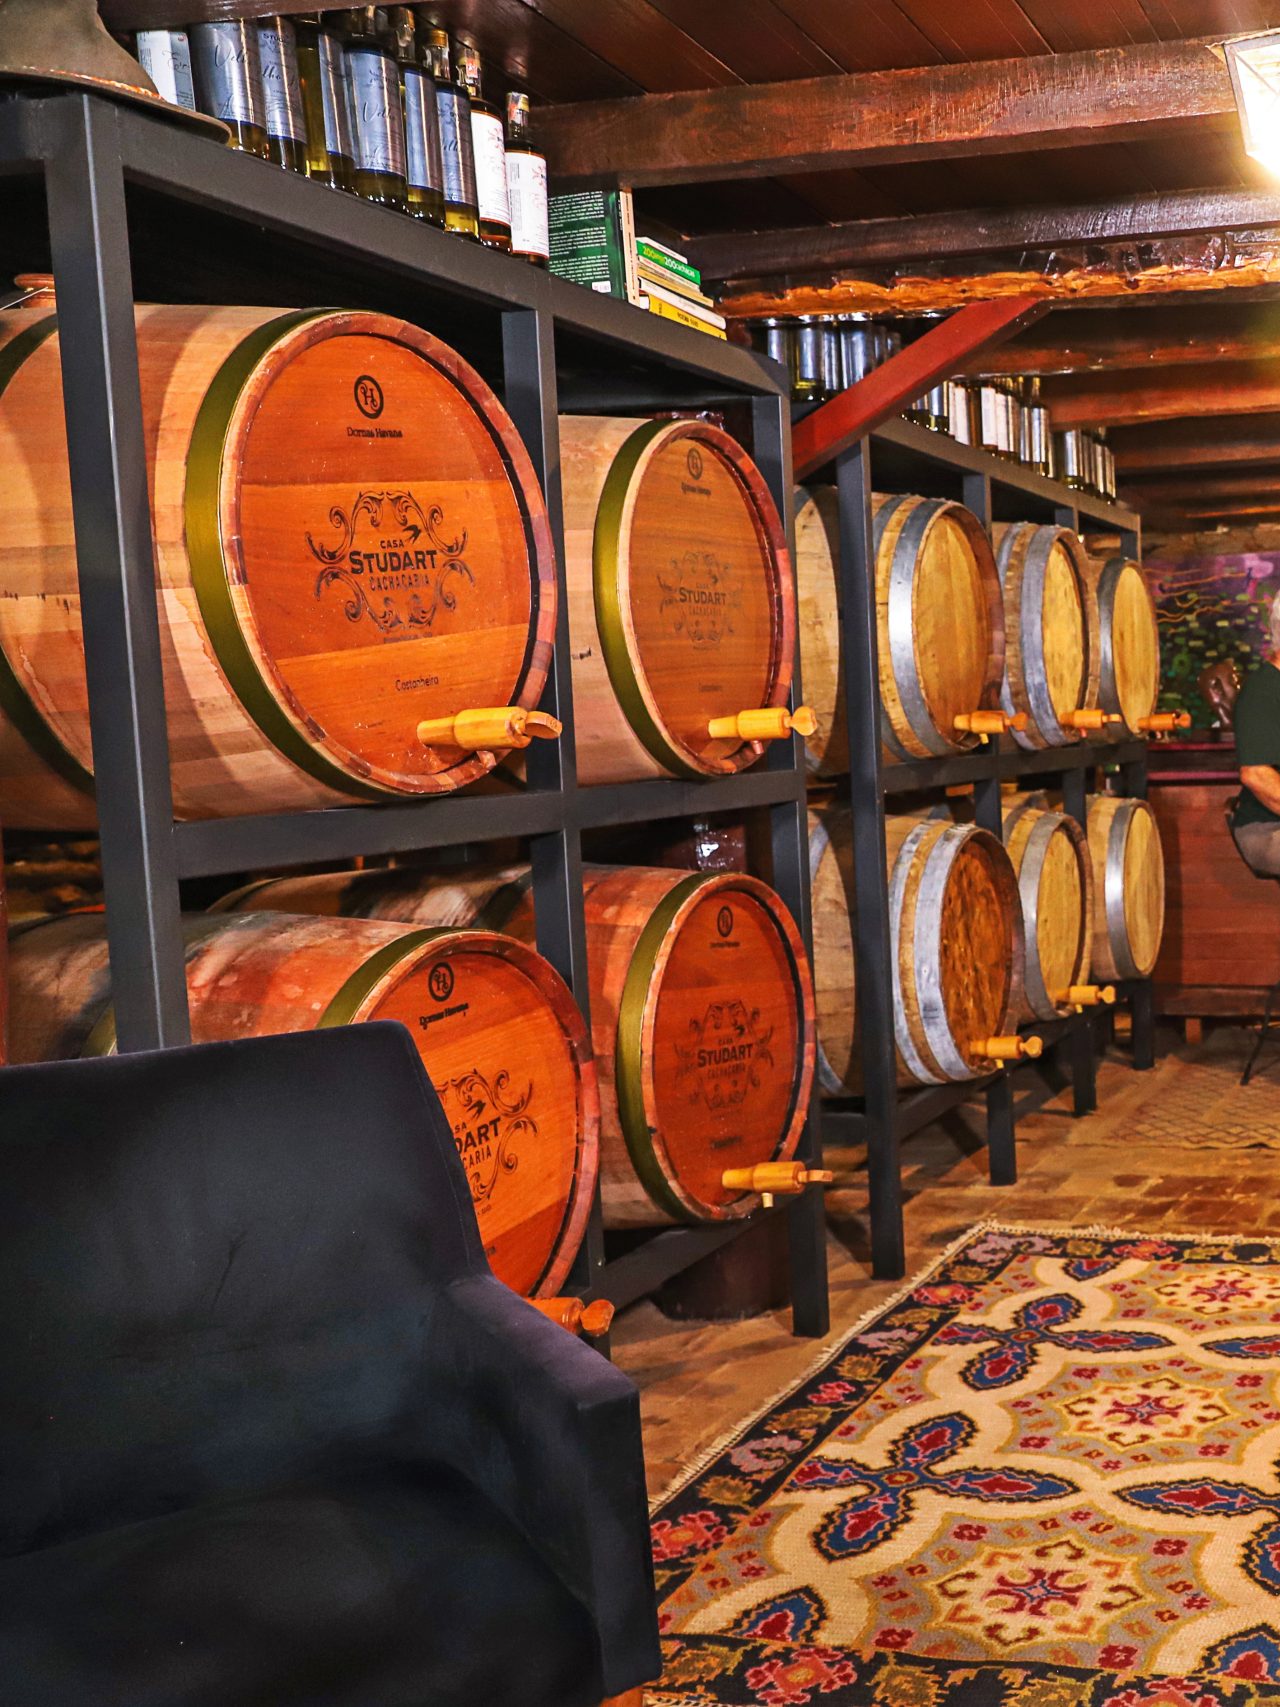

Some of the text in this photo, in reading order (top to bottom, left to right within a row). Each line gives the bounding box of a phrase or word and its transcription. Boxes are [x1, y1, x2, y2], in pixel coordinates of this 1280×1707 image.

[380, 539, 404, 549] CASA
[349, 550, 437, 574] STUDART
[679, 587, 727, 606] STUDART
[698, 1043, 753, 1068] STUDART
[454, 1121, 468, 1134] SA
[454, 1116, 501, 1154] DART
